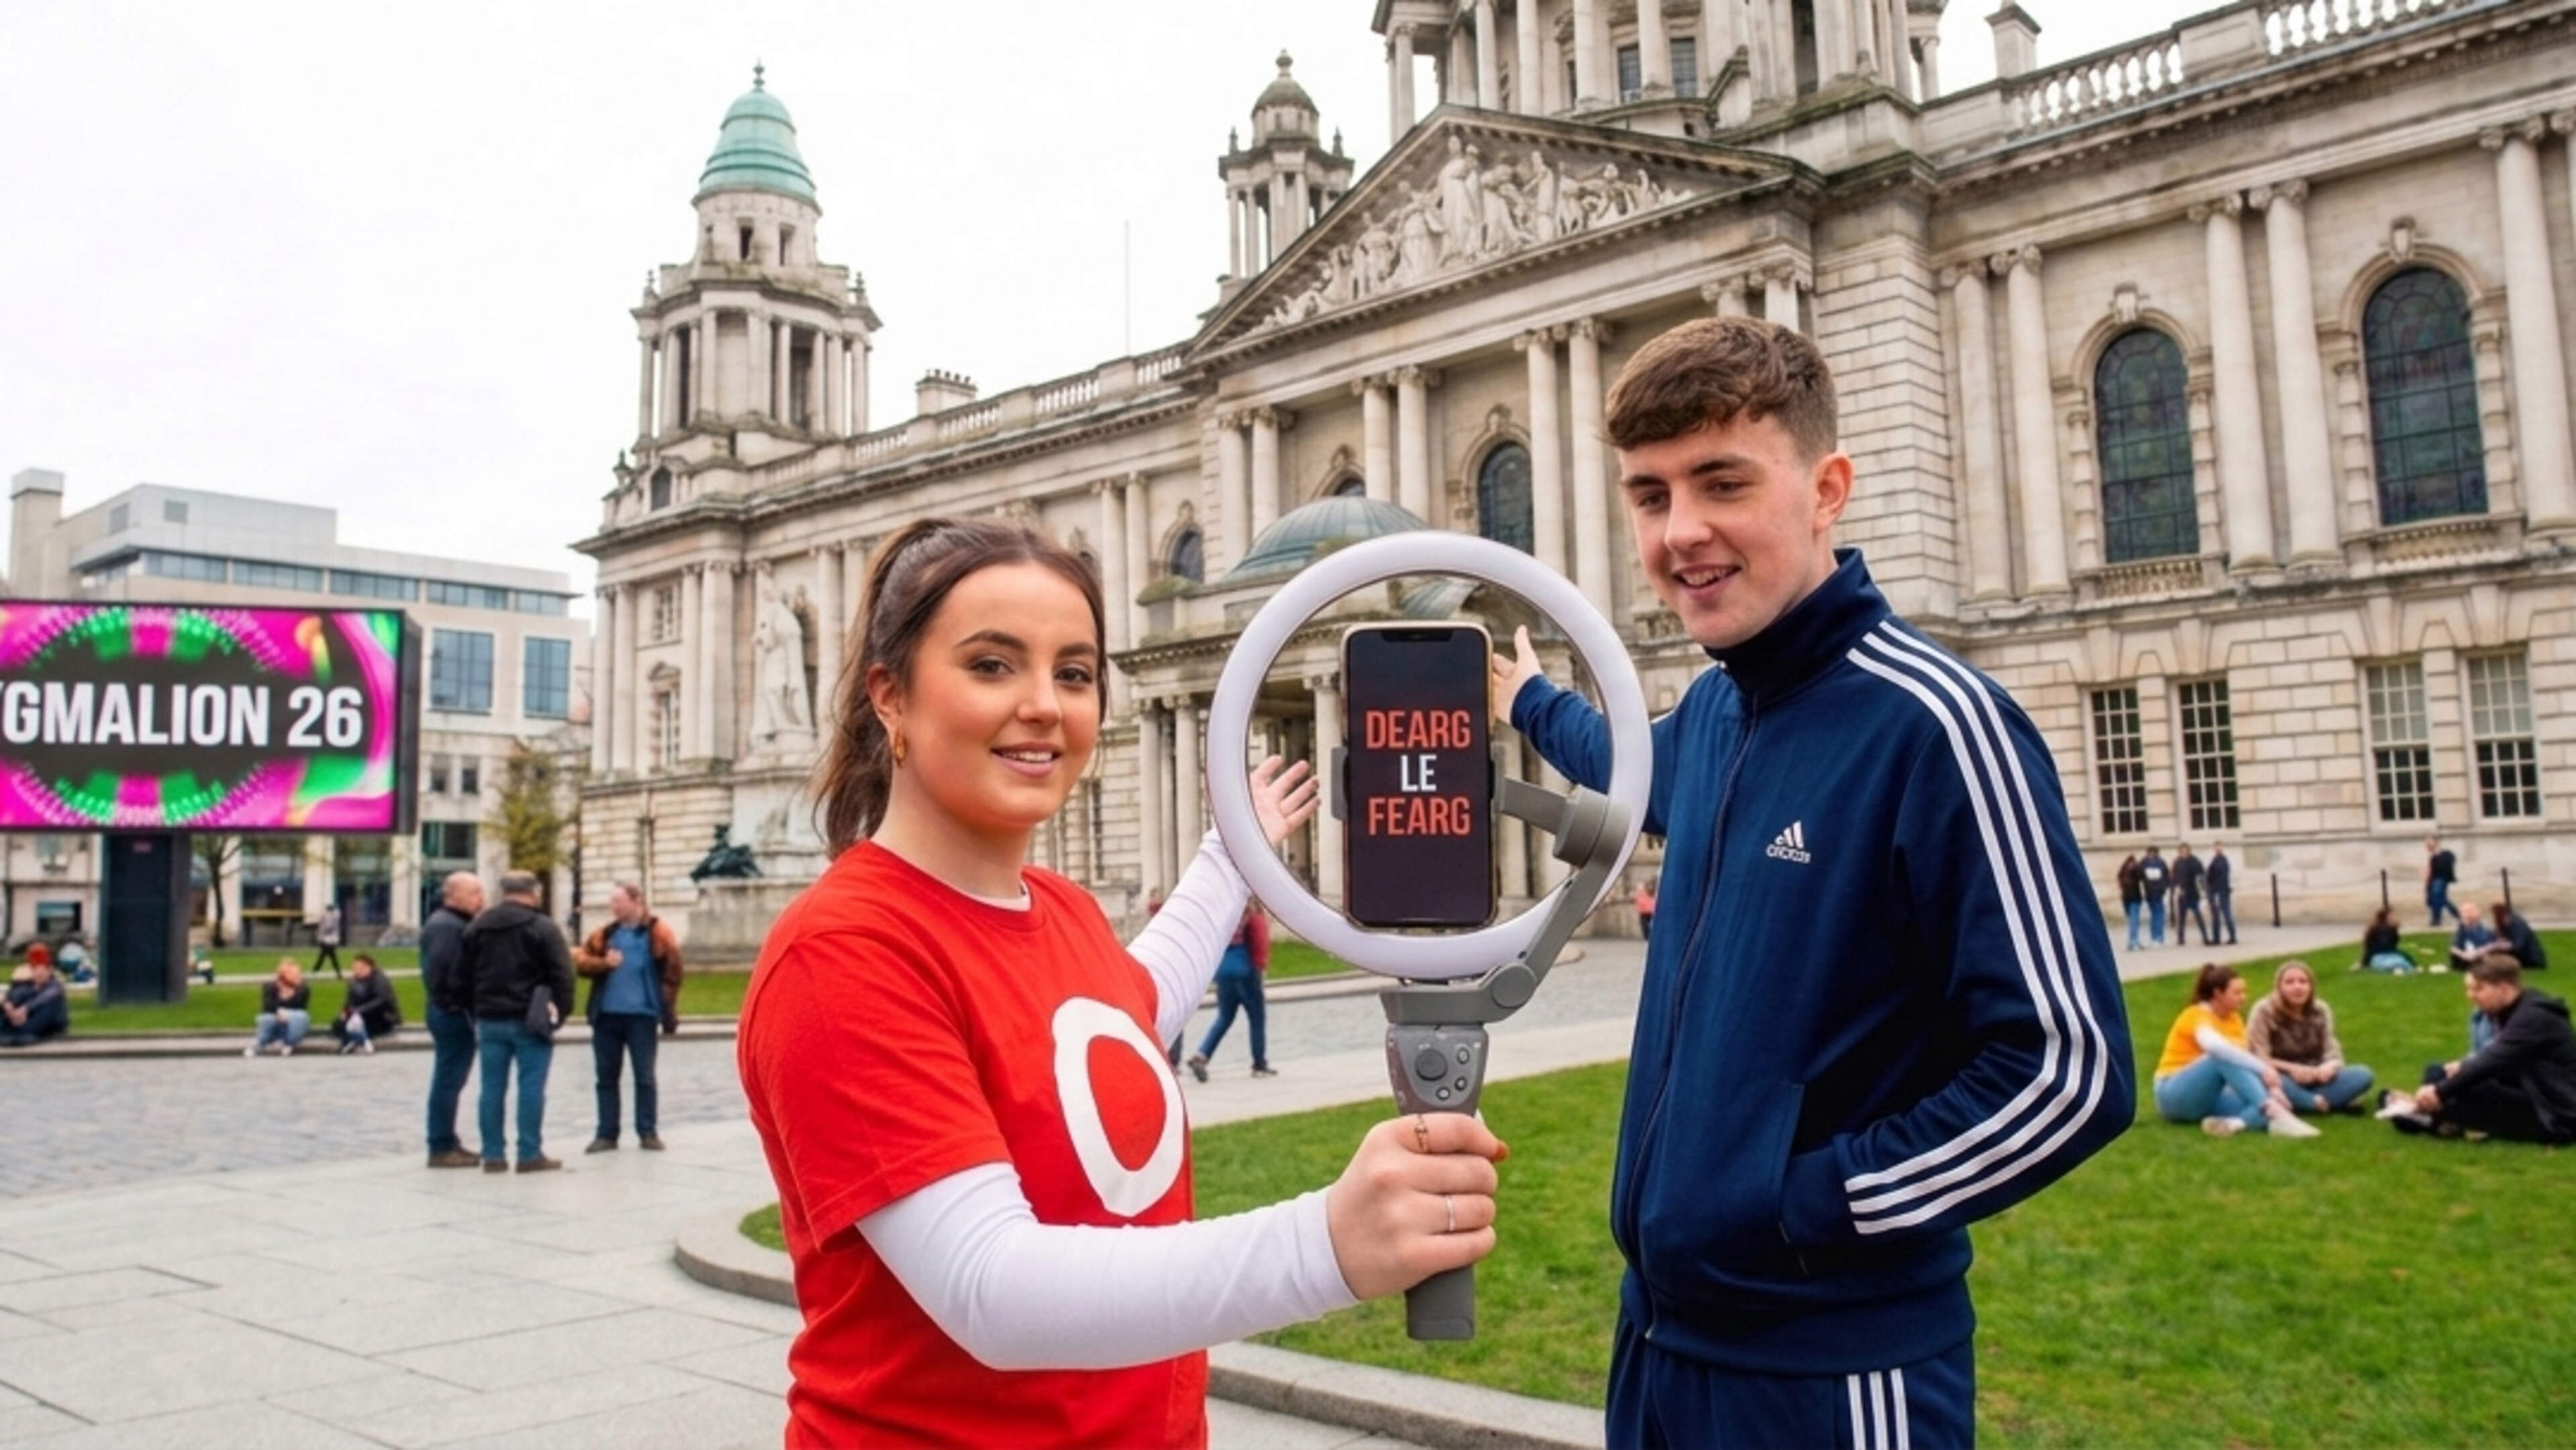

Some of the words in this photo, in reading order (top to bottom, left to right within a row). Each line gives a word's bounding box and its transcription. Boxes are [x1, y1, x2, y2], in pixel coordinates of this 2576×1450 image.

[0, 681, 270, 746] GMALION
[287, 685, 363, 748] 26
[1366, 710, 1472, 749] DEARG
[1400, 754, 1437, 792] LE
[1368, 795, 1472, 836] FEARG
